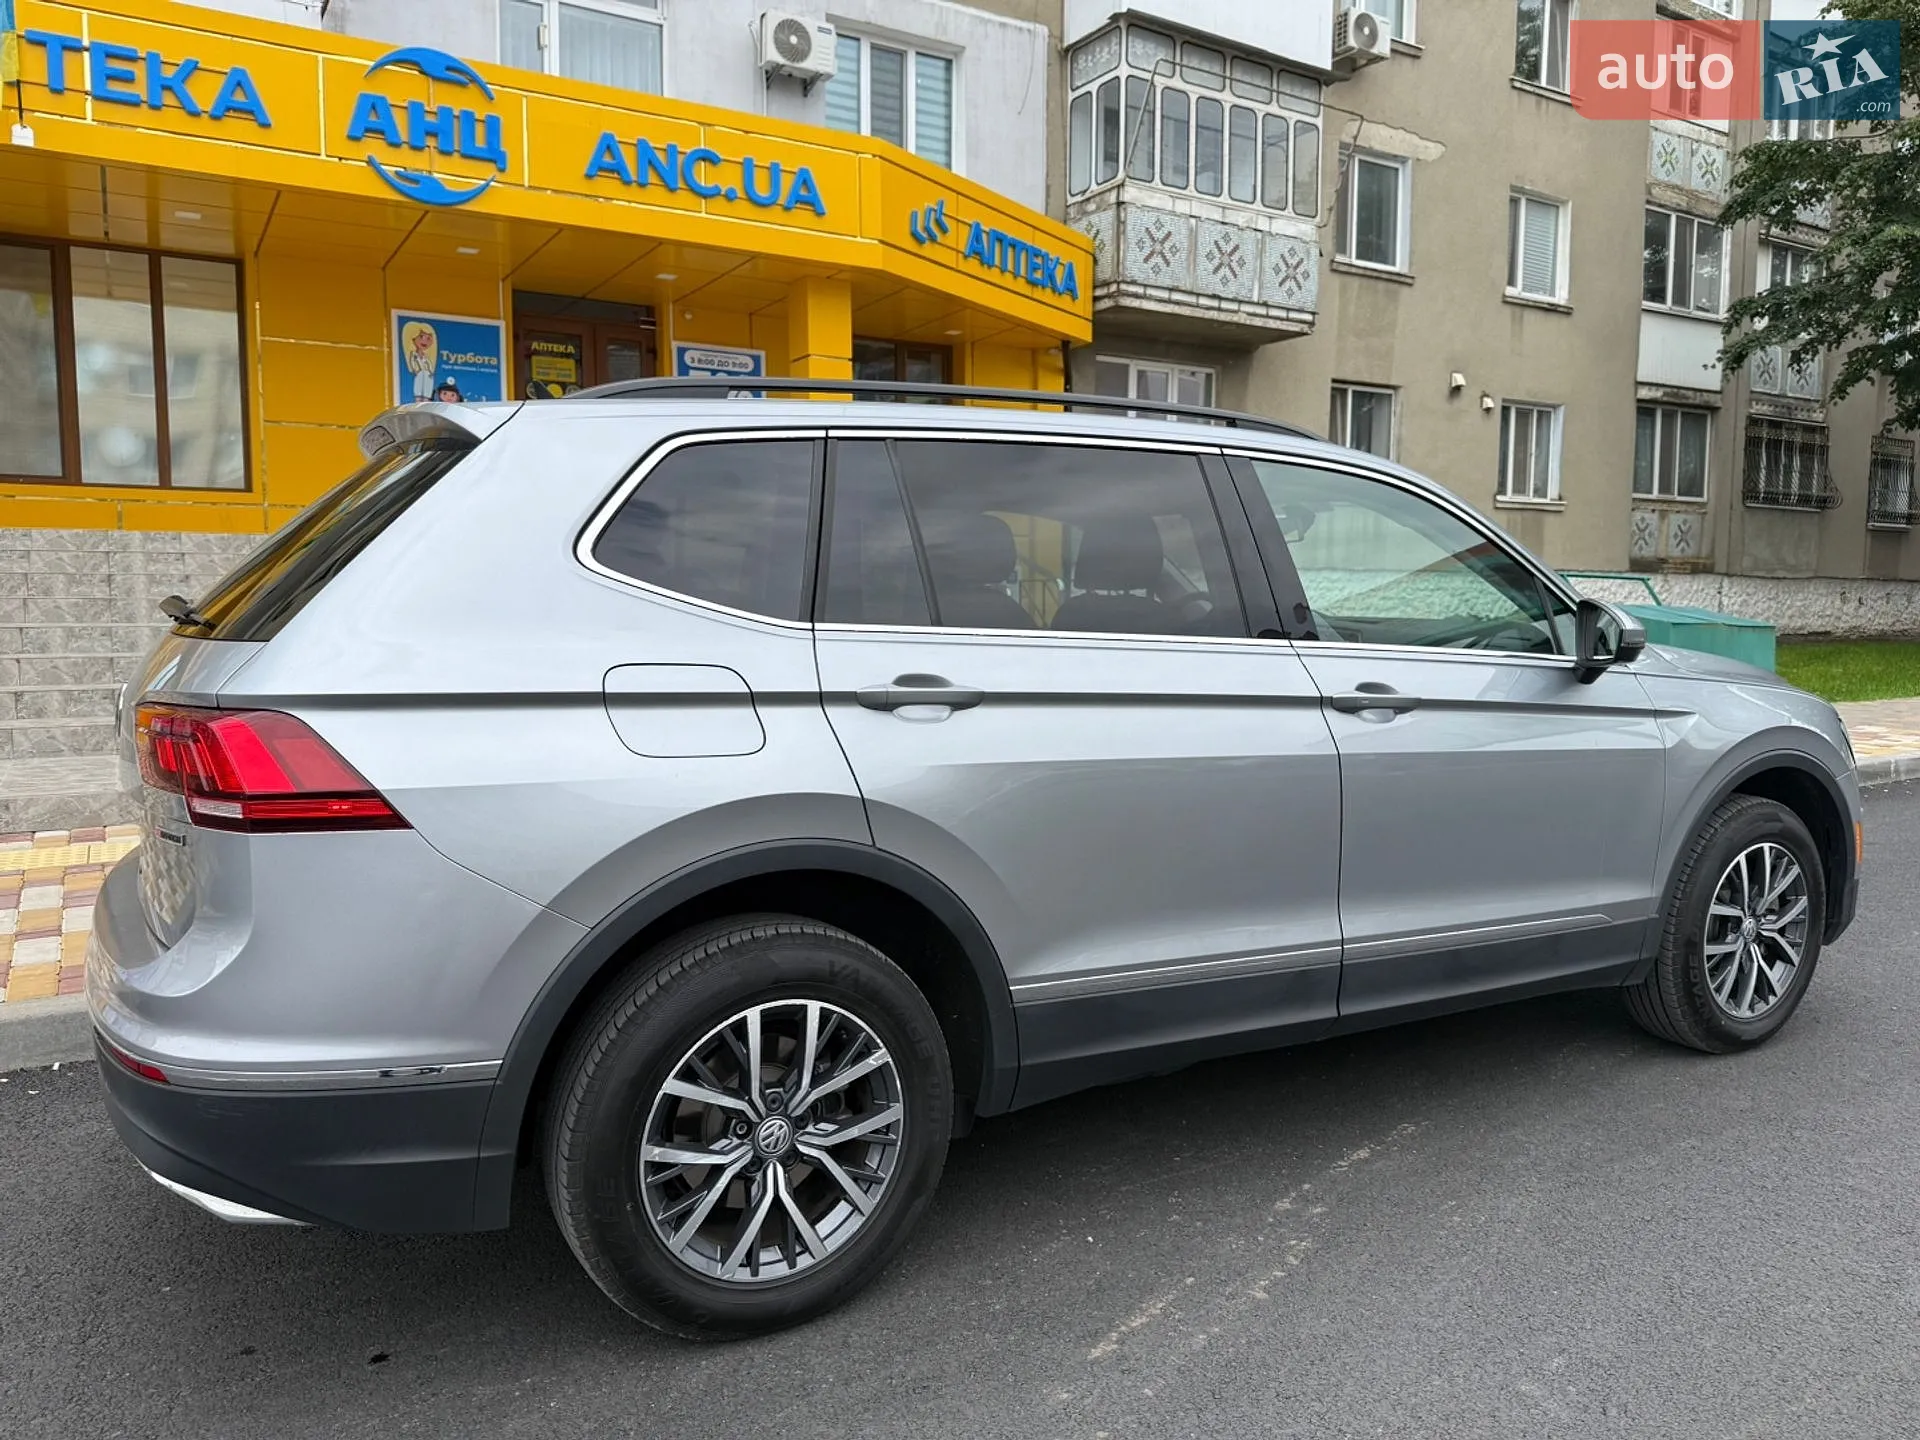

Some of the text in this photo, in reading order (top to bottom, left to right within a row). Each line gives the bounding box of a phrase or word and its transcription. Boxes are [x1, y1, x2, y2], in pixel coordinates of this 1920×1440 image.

[24, 29, 271, 128] ТЕКА
[347, 93, 507, 171] АНЦ
[584, 131, 826, 216] ANC.UA
[964, 221, 1078, 300] АПТЕКА
[440, 350, 498, 365] Турбота
[531, 341, 576, 354] АПТЕКА
